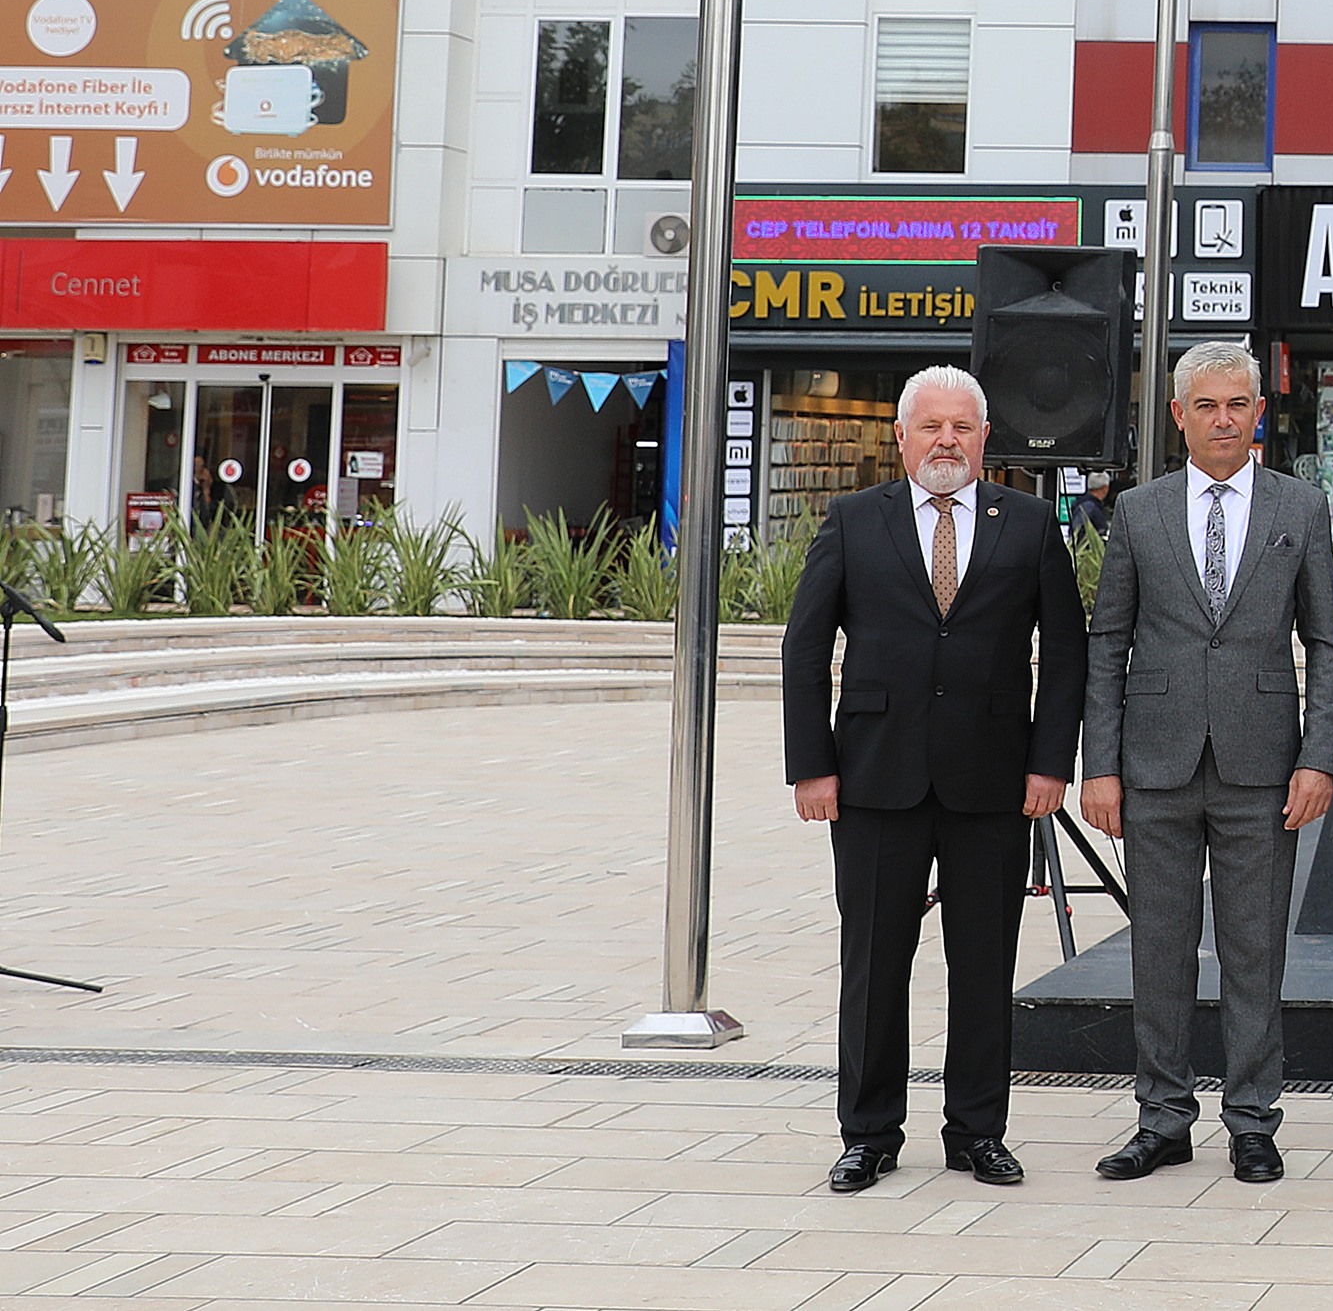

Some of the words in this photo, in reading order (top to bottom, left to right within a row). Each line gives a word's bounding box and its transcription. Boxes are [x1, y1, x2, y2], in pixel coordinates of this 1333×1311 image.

[82, 79, 128, 95] Fiber
[131, 76, 153, 95] İle
[38, 99, 111, 116] İnternet
[114, 100, 159, 119] Keyfi
[254, 164, 374, 189] vodafone
[745, 219, 790, 240] CEP
[792, 219, 956, 240] TELEFONLARINA
[959, 220, 982, 240] 12
[987, 217, 1060, 240] TAKSİT
[50, 271, 141, 298] Cennet
[480, 269, 556, 292] MUSA
[1189, 280, 1245, 295] Teknik
[512, 297, 539, 332] İŞ
[544, 297, 660, 326] MERKEZİ
[1191, 299, 1243, 314] Servis
[207, 348, 259, 362] ABONE
[260, 347, 325, 363] MERKEZİ
